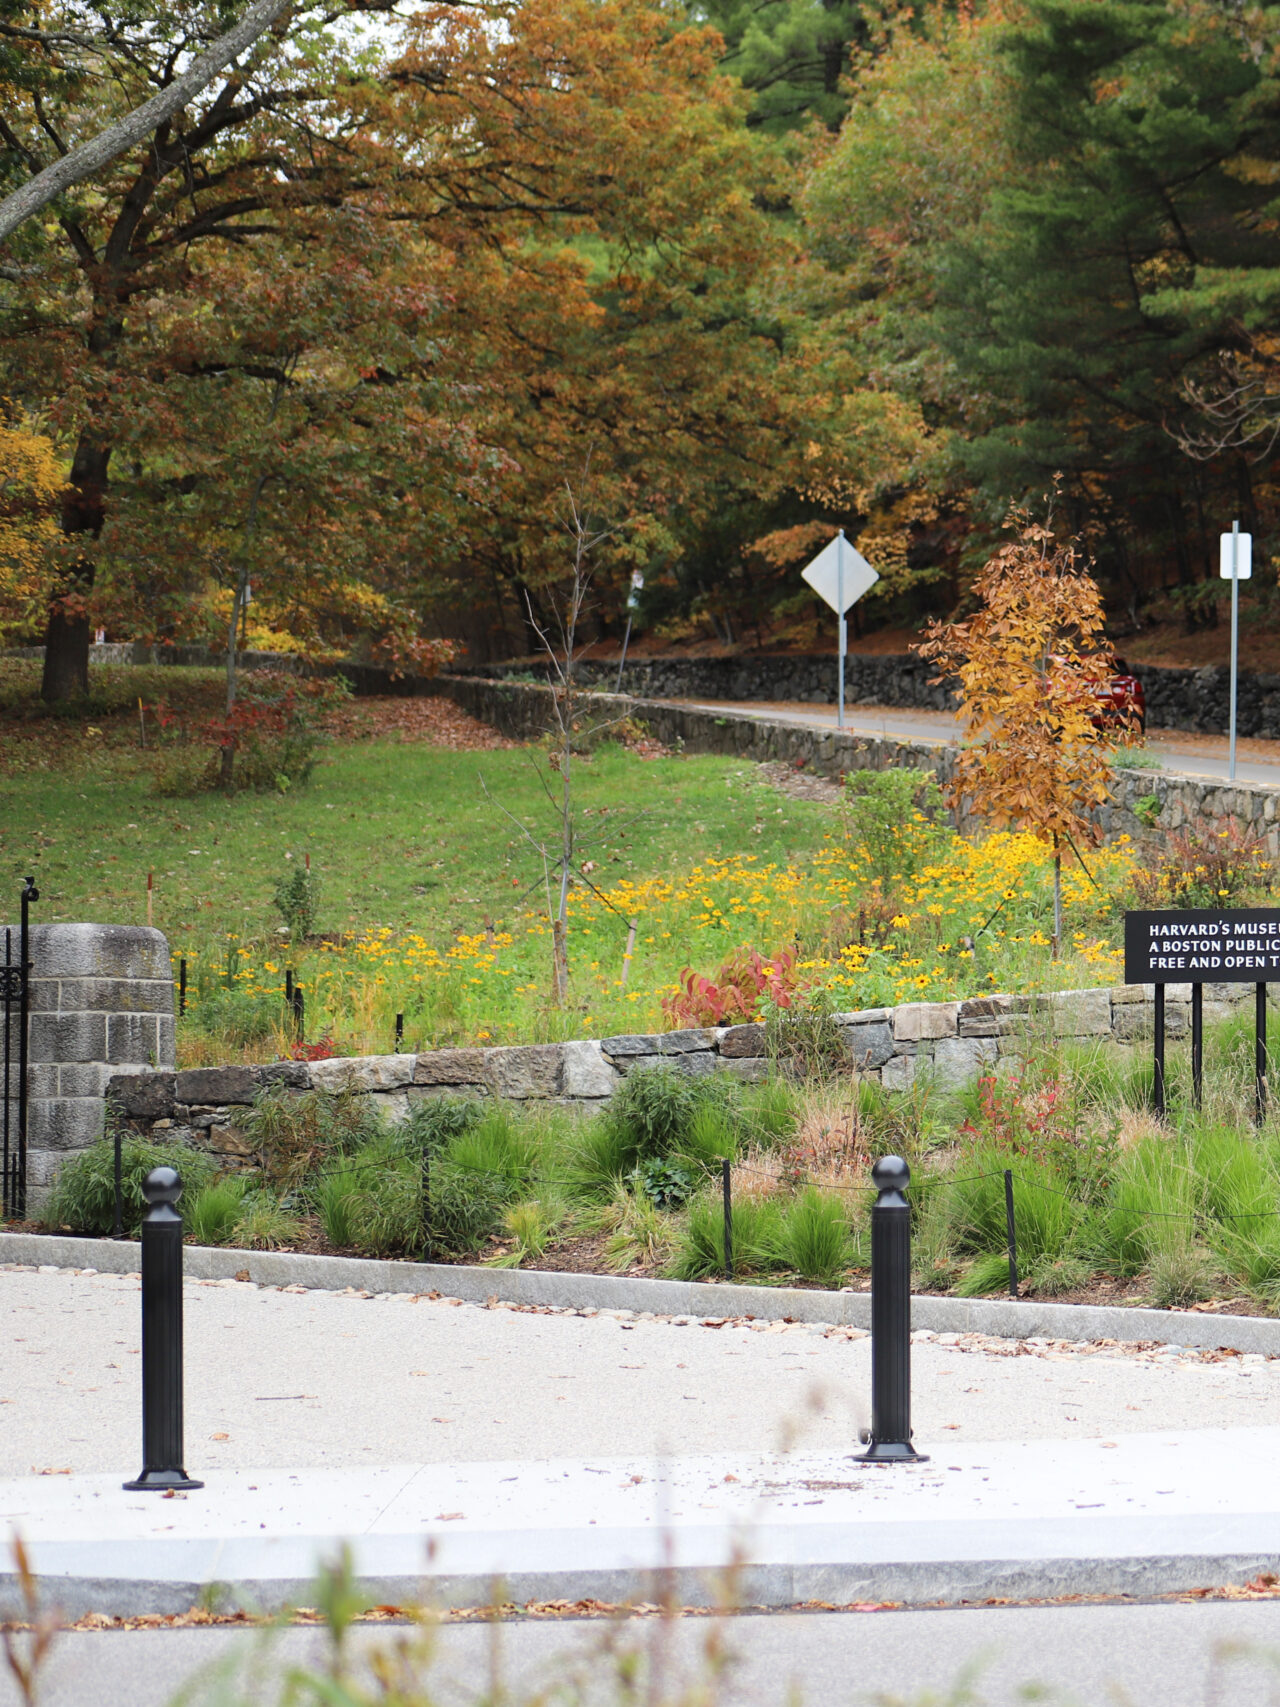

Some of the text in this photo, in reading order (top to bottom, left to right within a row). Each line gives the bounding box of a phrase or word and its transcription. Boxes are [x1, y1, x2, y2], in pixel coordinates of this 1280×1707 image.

[1149, 920, 1230, 936] HARVARD'S
[1149, 941, 1159, 953] A
[1162, 940, 1221, 952] BOSTON
[1225, 939, 1280, 951] PUBLIC
[1149, 956, 1185, 969] FREE
[1189, 956, 1221, 968] AND
[1224, 955, 1265, 968] OPEN
